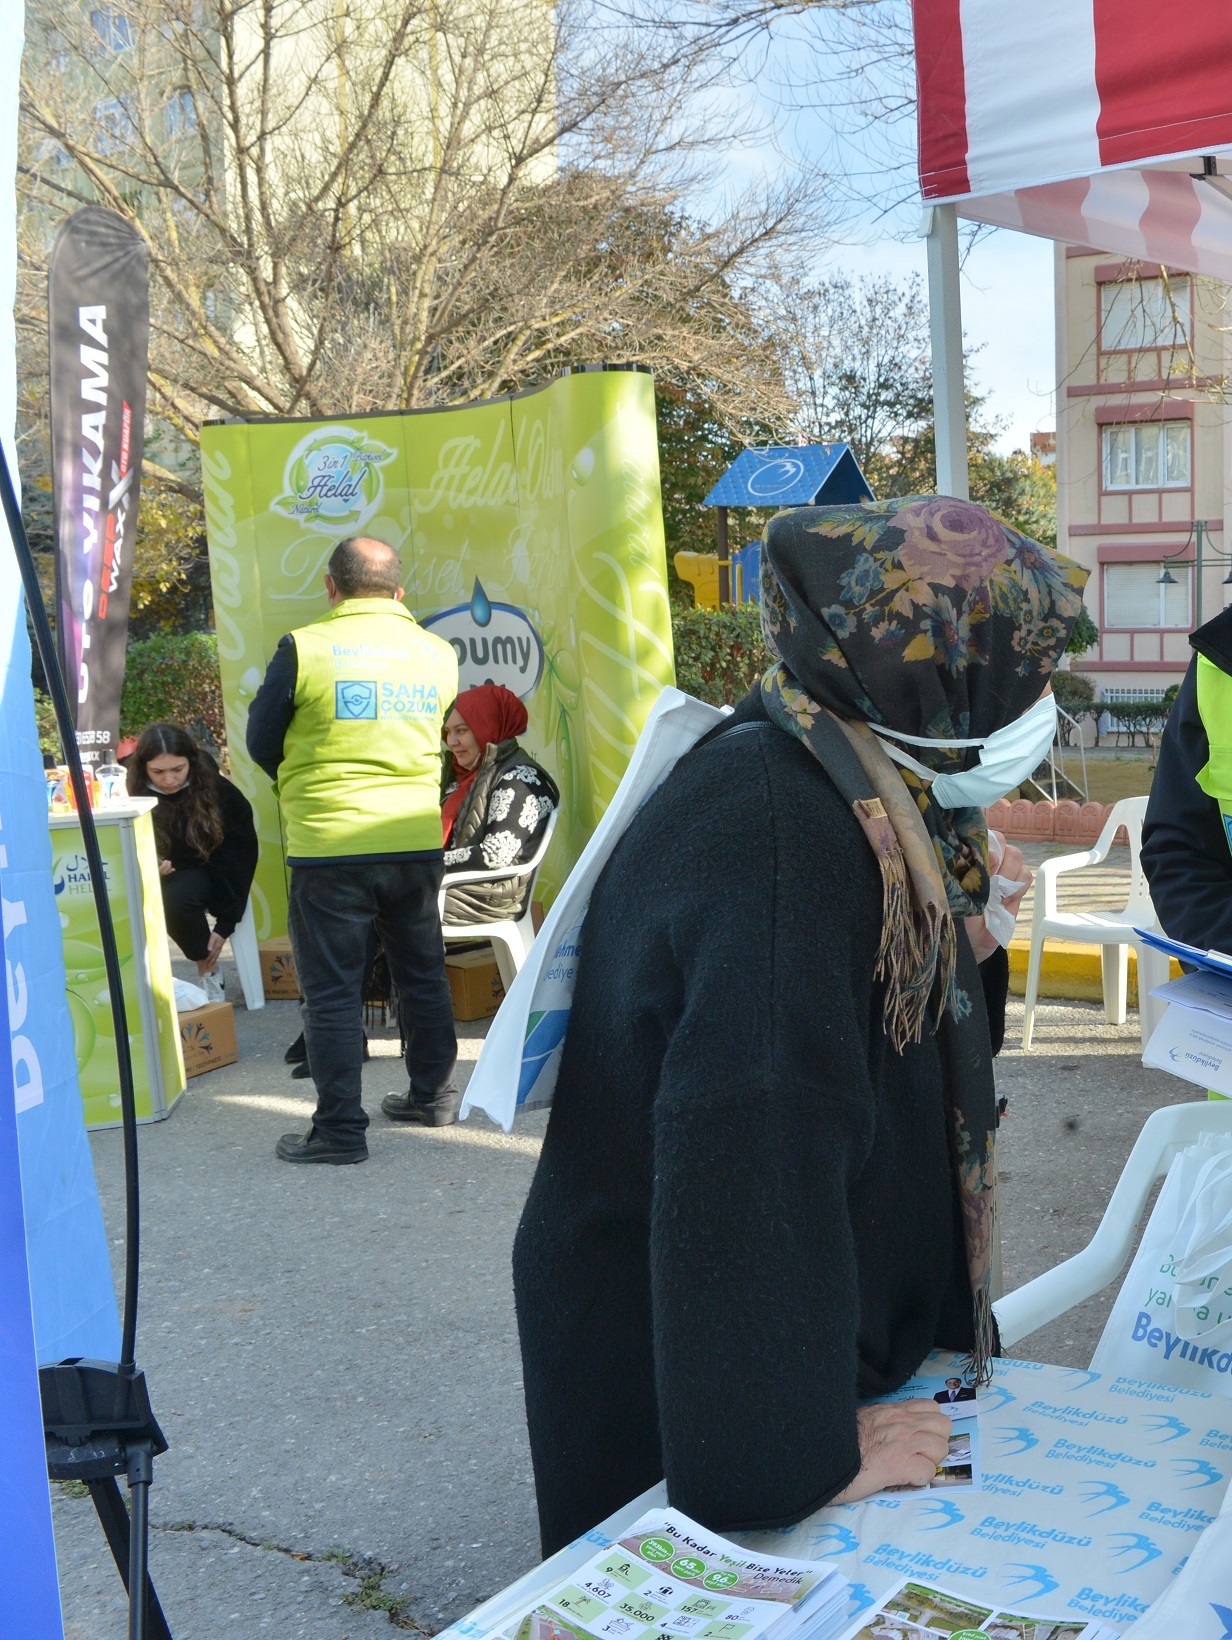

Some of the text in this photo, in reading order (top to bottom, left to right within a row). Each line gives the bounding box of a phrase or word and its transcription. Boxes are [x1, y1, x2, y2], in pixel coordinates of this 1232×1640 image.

[79, 305, 109, 554] YIKAMA
[298, 469, 368, 500] Helal
[381, 682, 439, 699] SAHA
[1184, 1052, 1220, 1071] Beylikdüzü
[1109, 1383, 1177, 1404] Belediyesi
[1022, 1406, 1089, 1428] Belediyesi
[1030, 1400, 1129, 1426] Beylikdüzü
[1044, 1449, 1118, 1470] Belediyesi
[1053, 1438, 1157, 1469] Beylikdüzü
[969, 1527, 1049, 1551] Belediyesi
[978, 1516, 1093, 1549] Beylikdüzü
[679, 1559, 694, 1570] 65
[682, 1535, 717, 1559] Kadar
[718, 1553, 747, 1569] Yeşil
[745, 1562, 771, 1574] Bize
[872, 1543, 989, 1579] Beylikdüzü
[753, 1571, 804, 1585] Demedik
[862, 1554, 941, 1582] Belediyesi
[585, 1582, 612, 1599] 4.607
[558, 1598, 571, 1608] 18
[619, 1603, 655, 1622] 35.000
[680, 1605, 698, 1613] 157
